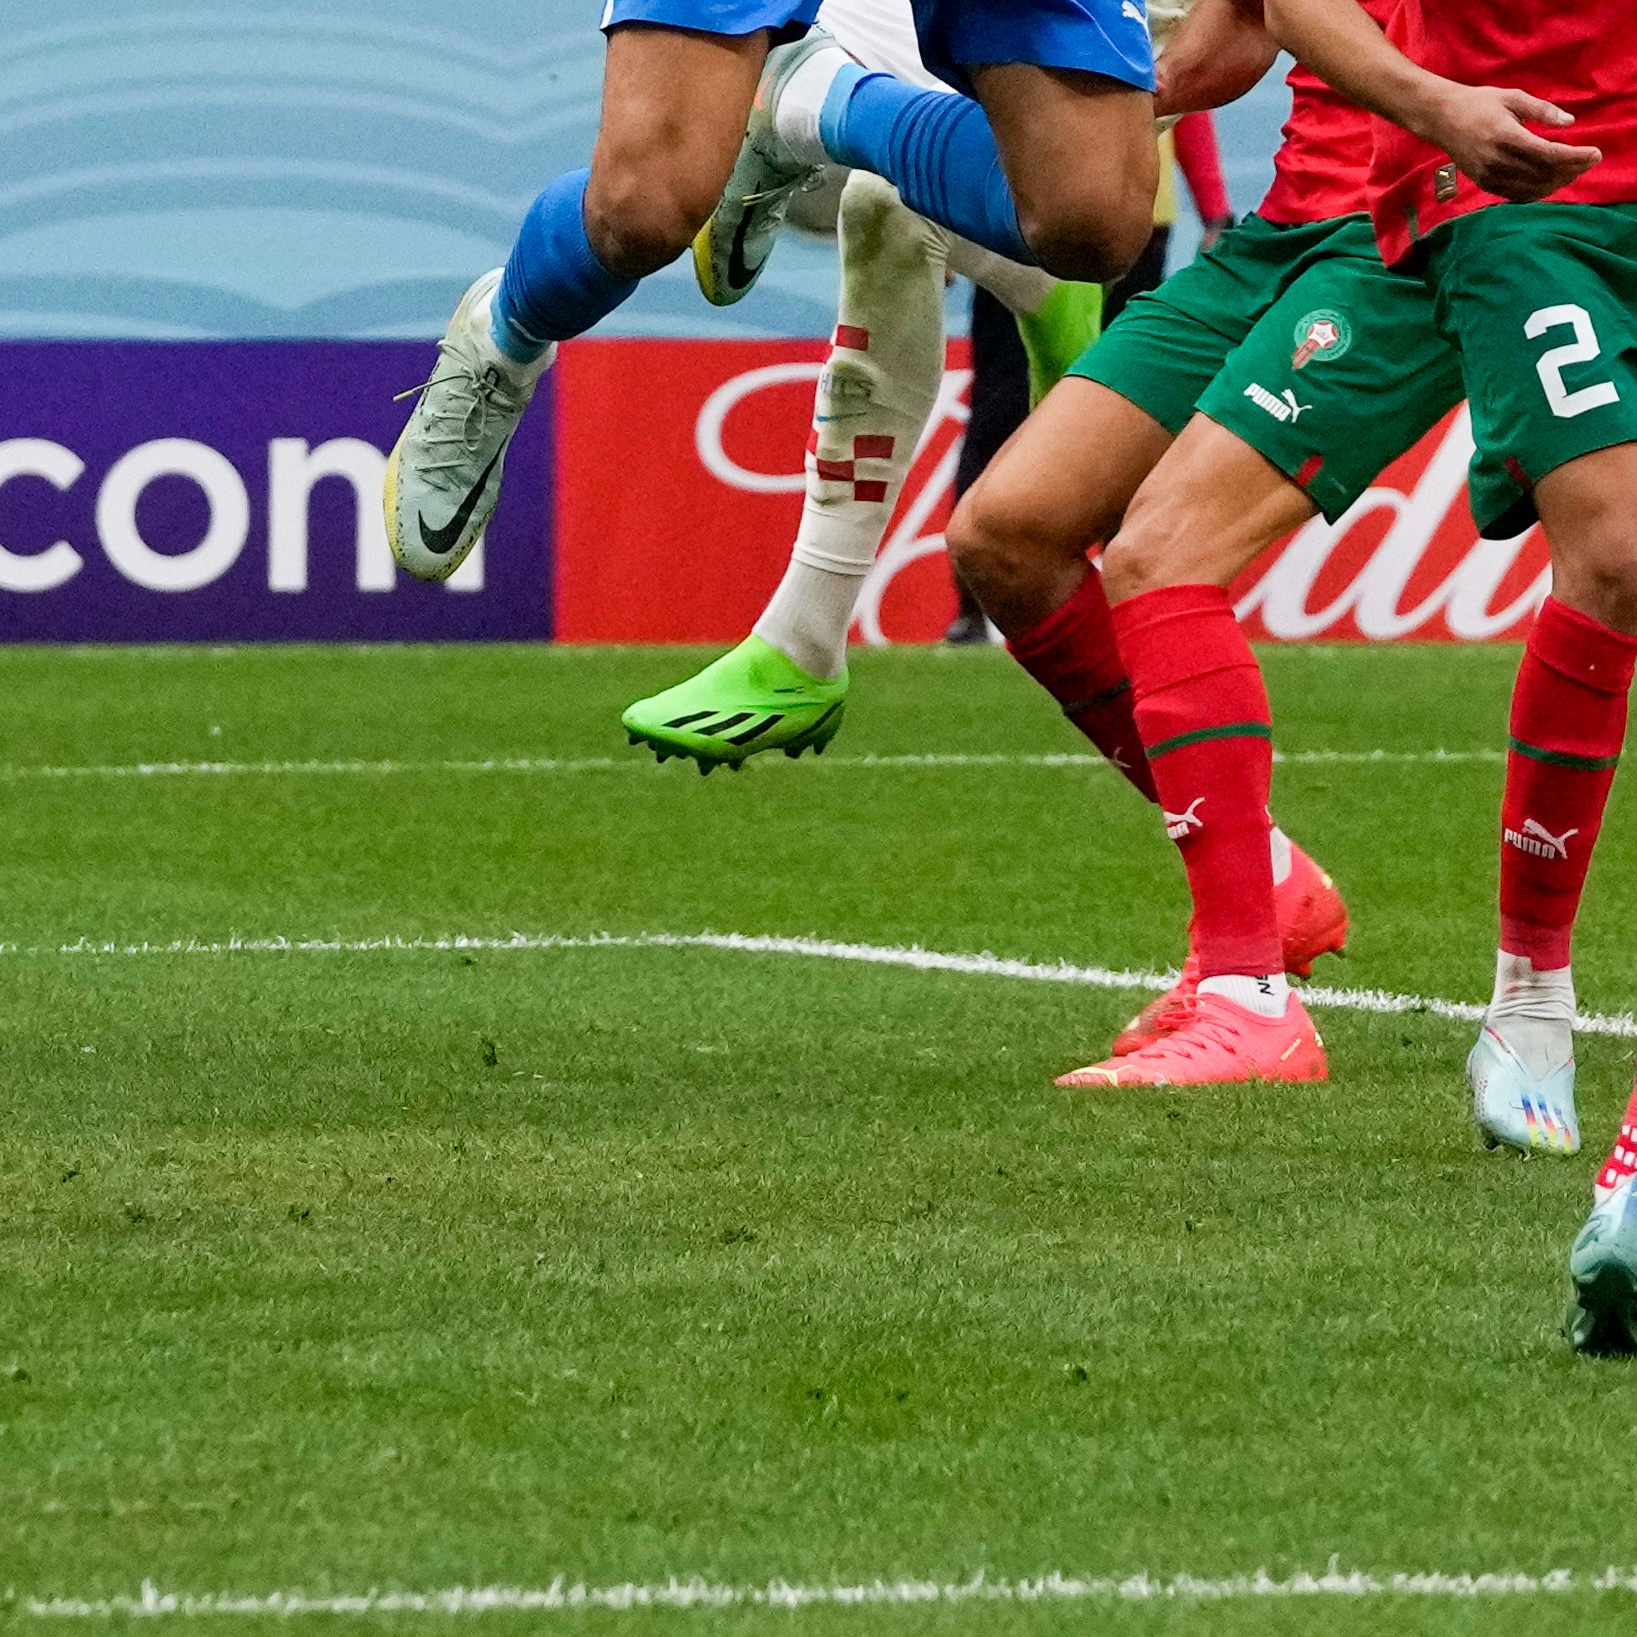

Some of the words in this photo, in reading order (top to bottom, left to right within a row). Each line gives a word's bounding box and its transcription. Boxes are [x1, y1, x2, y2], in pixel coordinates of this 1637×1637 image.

[1523, 304, 1621, 418] 2
[1243, 382, 1292, 422] PUMA
[1504, 828, 1556, 860] PUMA
